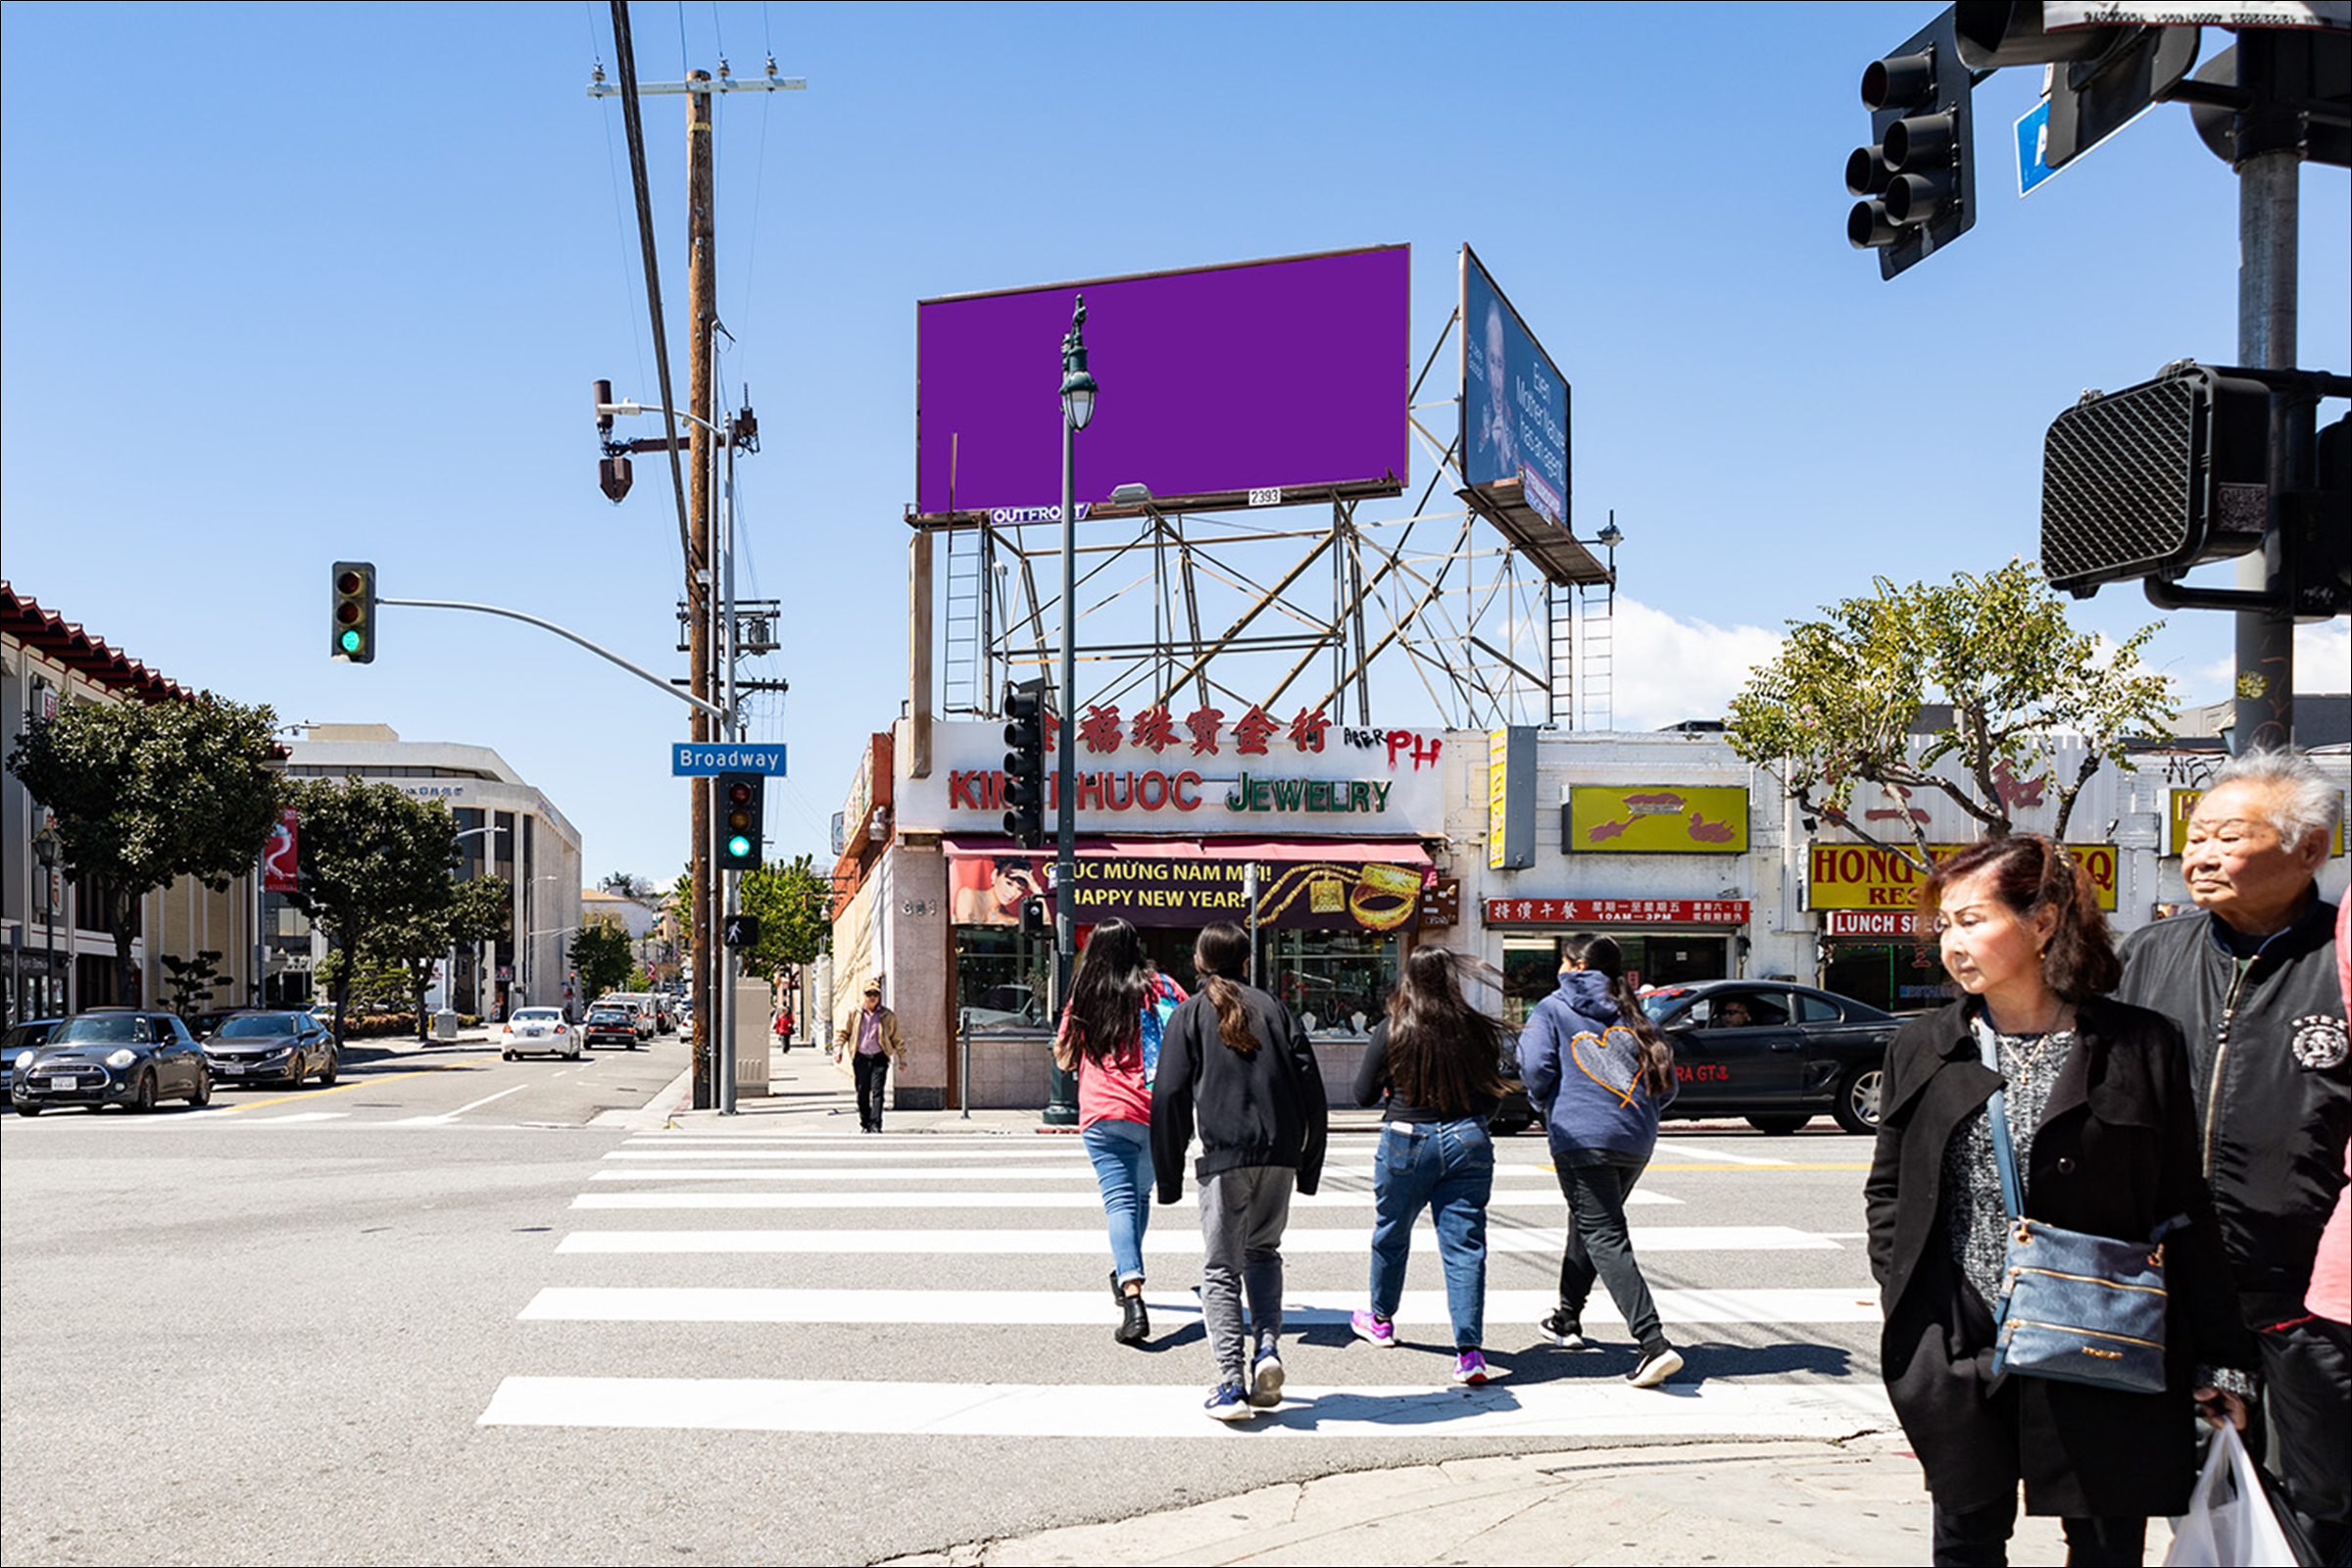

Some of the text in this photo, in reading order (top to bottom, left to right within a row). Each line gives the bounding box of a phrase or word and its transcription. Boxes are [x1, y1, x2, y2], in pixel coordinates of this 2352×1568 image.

[1251, 489, 1278, 503] 2393
[993, 505, 1084, 523] OUTFROT
[680, 750, 780, 771] Broadway
[1226, 772, 1393, 812] JEWELRY
[1225, 862, 1272, 882] MI!
[1814, 849, 1915, 884] HONG
[1138, 891, 1185, 906] NEW
[1189, 892, 1246, 907] YEAR!
[1494, 902, 1579, 919] 特價午餐
[1837, 914, 1894, 932] LUNCH
[1676, 1065, 1716, 1082] RA GT
